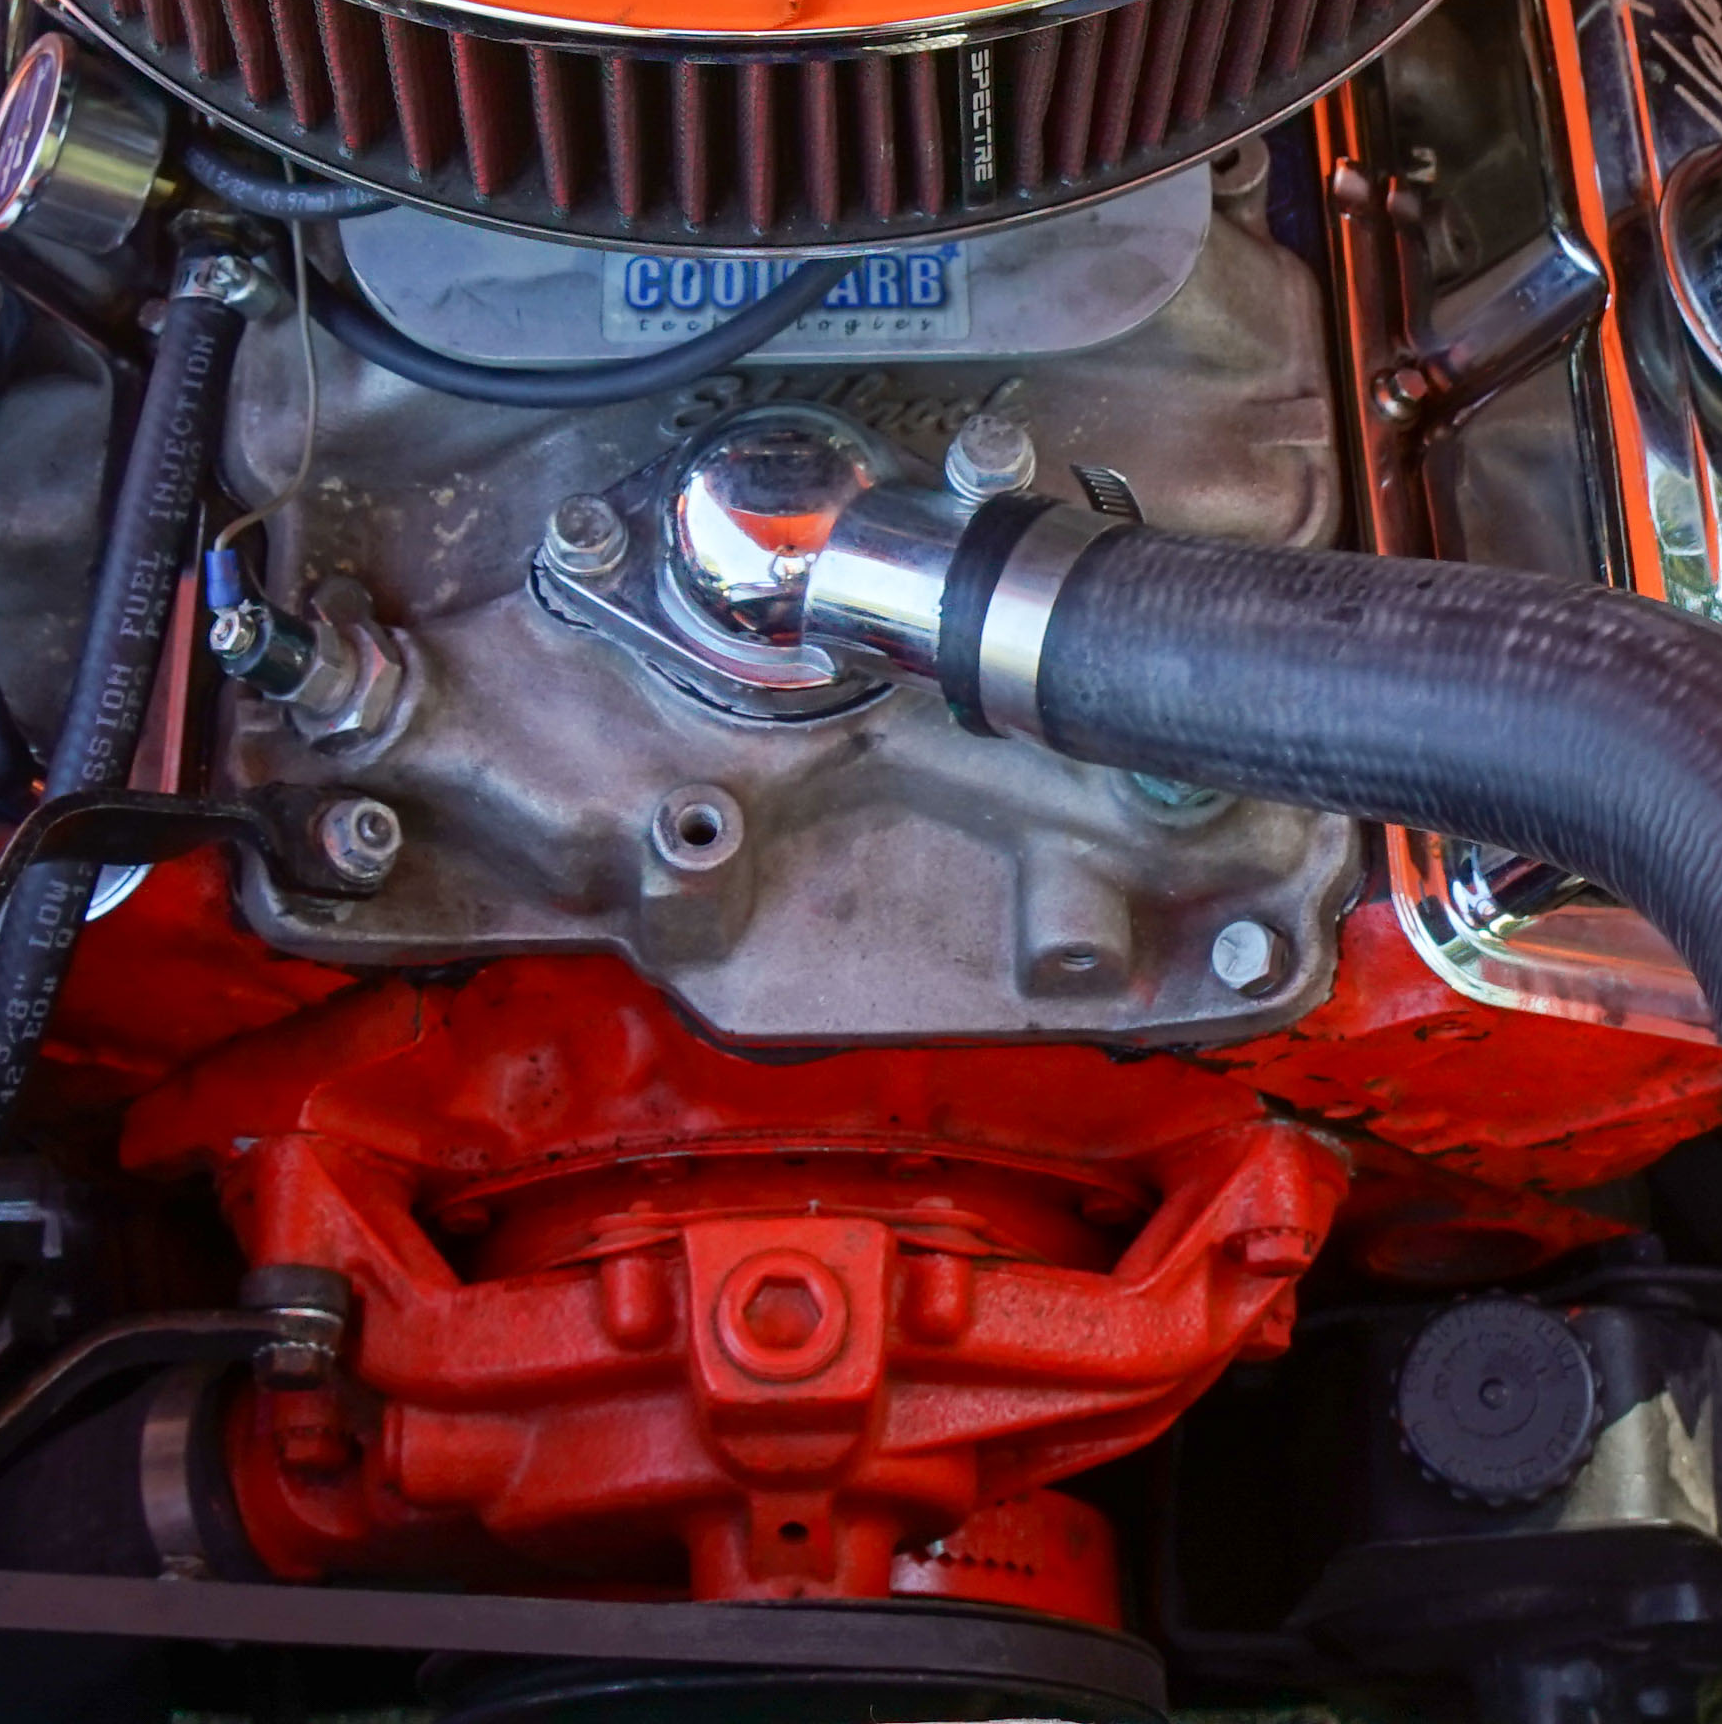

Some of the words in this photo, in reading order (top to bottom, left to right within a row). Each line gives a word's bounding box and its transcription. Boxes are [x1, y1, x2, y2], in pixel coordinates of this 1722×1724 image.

[970, 48, 994, 182] SPECTRE
[29, 879, 71, 950] LOW
[119, 550, 161, 639] FUEL
[149, 333, 216, 521] INJECTION
